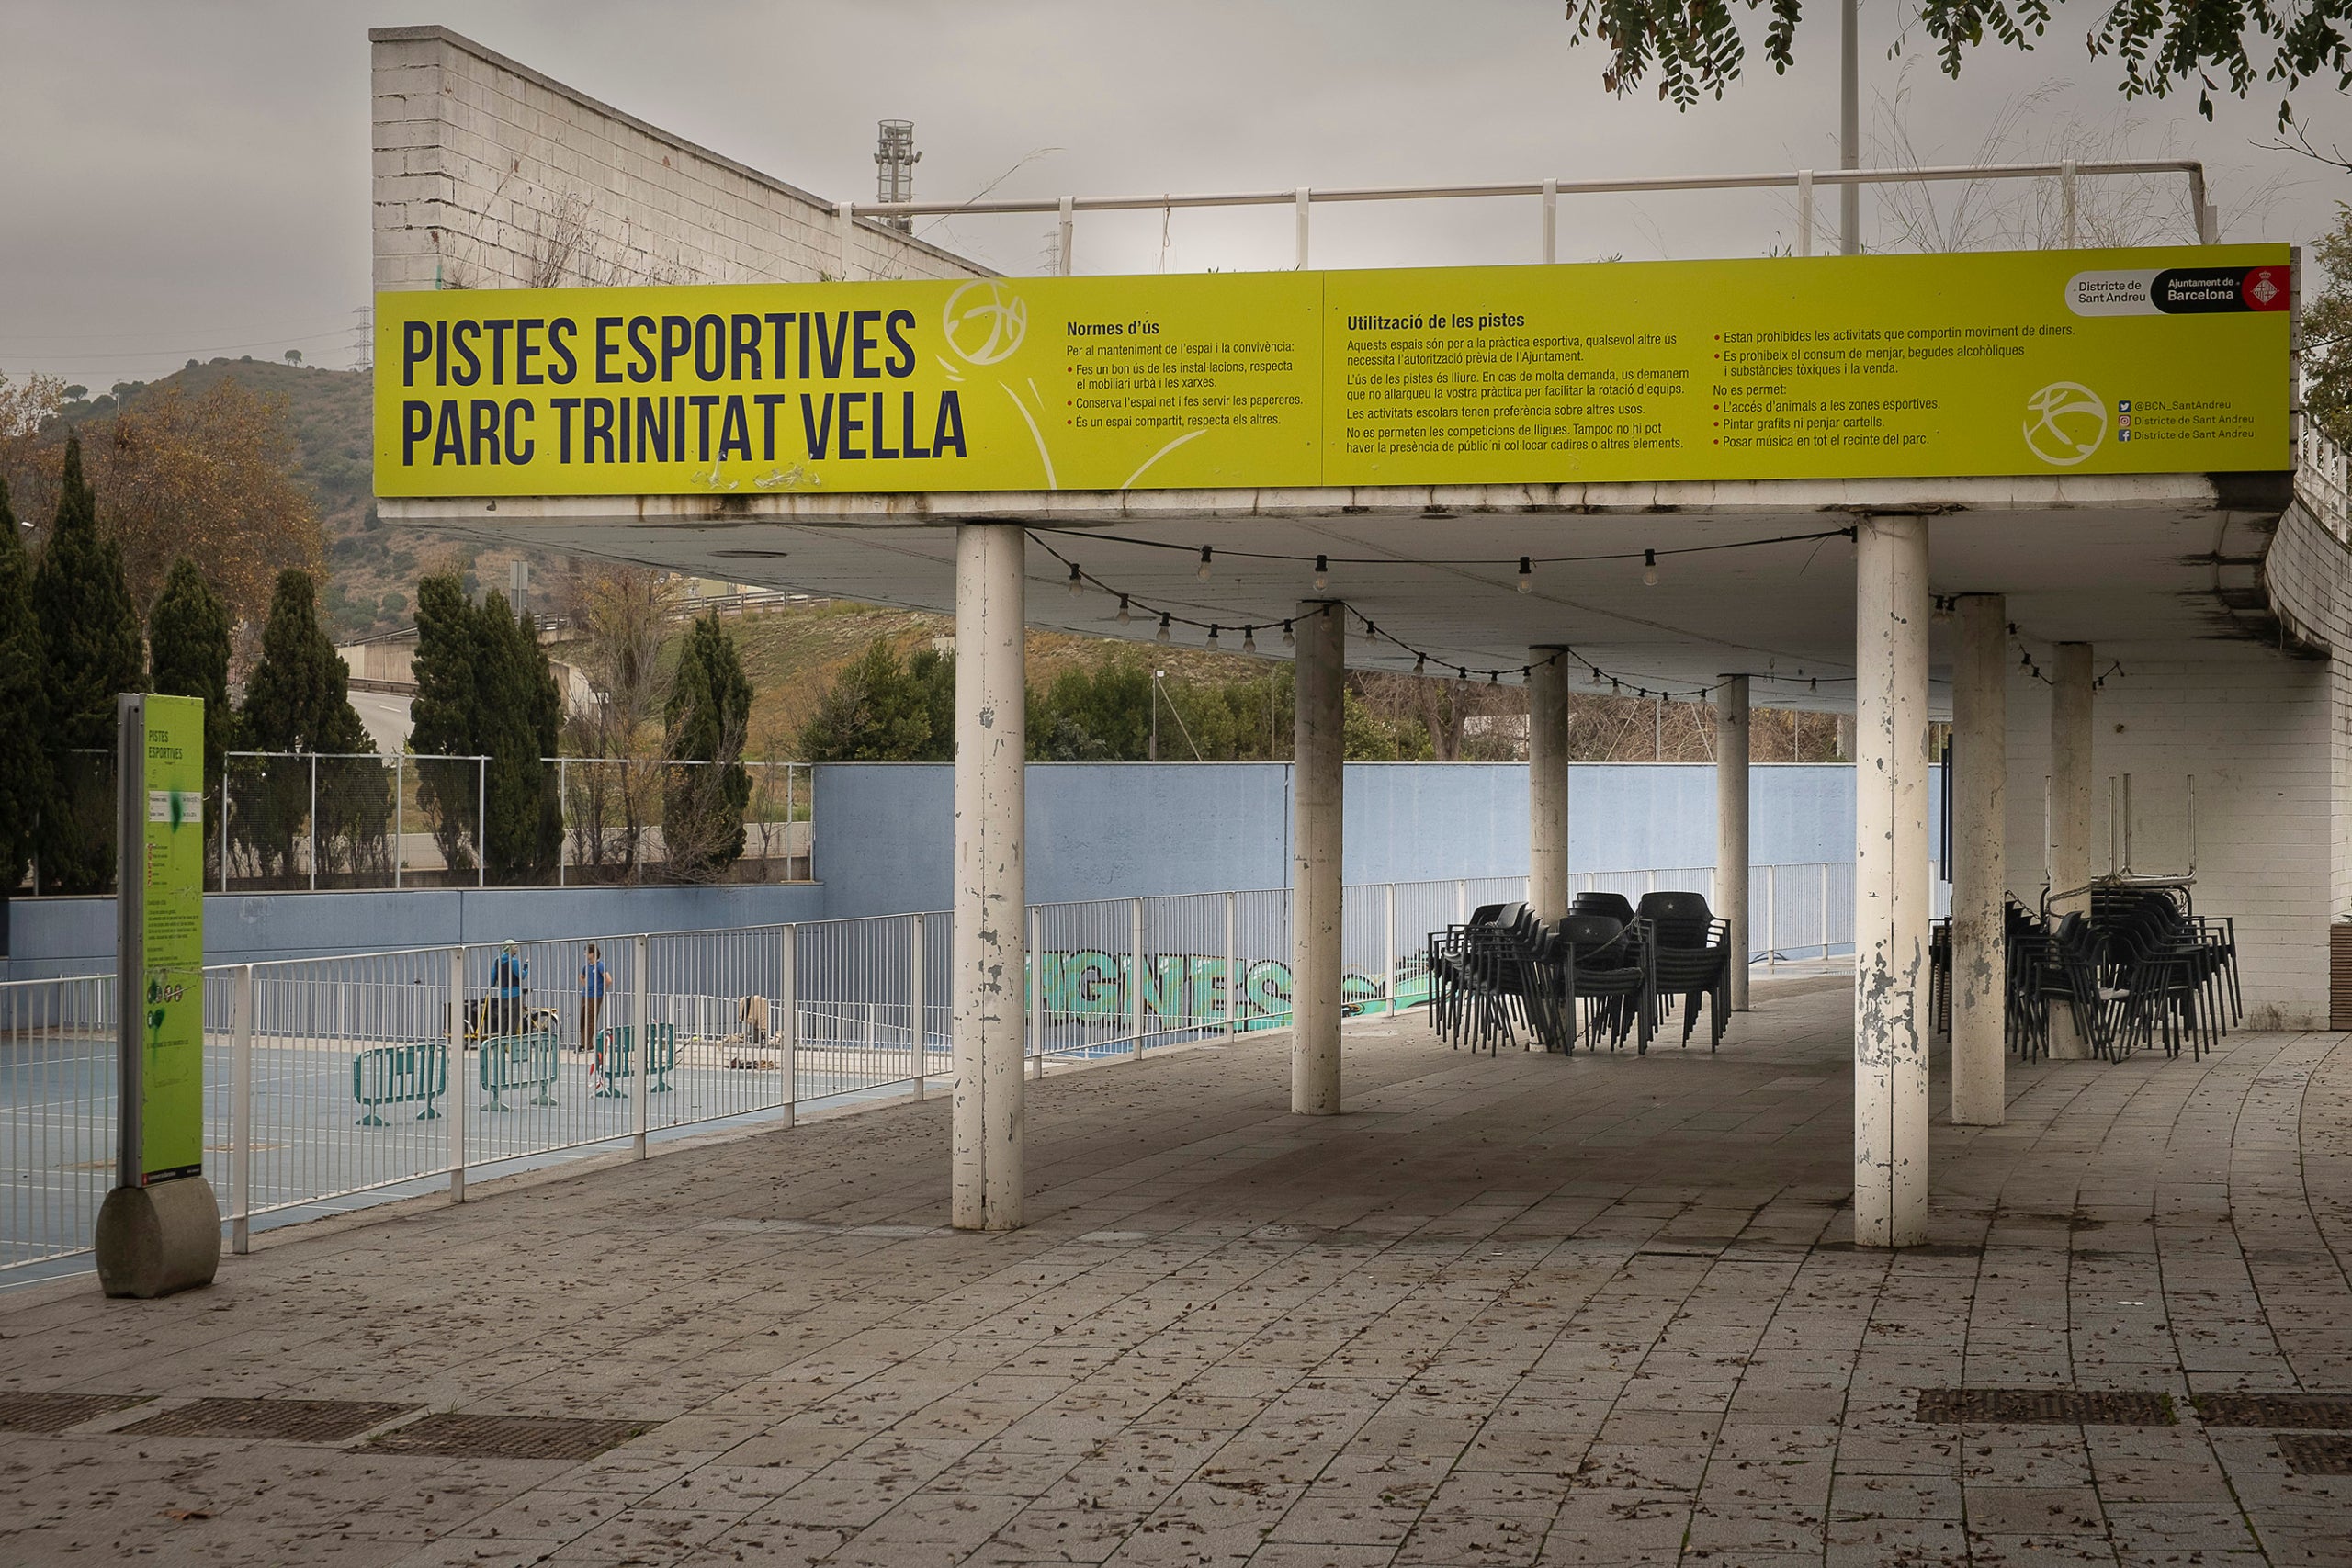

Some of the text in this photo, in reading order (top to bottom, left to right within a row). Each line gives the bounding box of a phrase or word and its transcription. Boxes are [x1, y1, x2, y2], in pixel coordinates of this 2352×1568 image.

[2078, 280, 2141, 291] Districte de
[2168, 277, 2233, 288] Ajuntament de
[2078, 293, 2145, 302] Sant Andreu
[2168, 289, 2233, 301] Barcelona
[1068, 320, 1159, 335] Normes d'ús
[1348, 312, 1524, 330] Utilització de les pistes
[1724, 324, 2075, 344] Estan prohibides les activitats que comportin moviment de diners.
[403, 310, 915, 386] PISTES ESPORTIVES
[1067, 345, 1082, 355] Per
[1085, 344, 1094, 355] al
[1097, 344, 1162, 355] manteniment
[1165, 344, 1177, 354] de
[1181, 342, 1212, 355] l'espai
[1222, 342, 1230, 352] la
[1233, 341, 1294, 352] convivència:
[1347, 333, 1677, 353] Aquests espais són per a la pràctica esportiva, qualsevol altre ús
[1347, 350, 1583, 365] necessita l'autorització prèvia de l'Ajuntament.
[1724, 344, 2024, 363] Es prohibeix el consum de menjar, begudes alcohòliques
[1076, 360, 1293, 374] Fes un bon ús de les instal·lacions, respecta
[1731, 364, 1793, 376] substàncies
[1796, 363, 1840, 377] tòxiques
[1851, 362, 1860, 374] la
[1863, 362, 1898, 373] venda.
[1077, 378, 1085, 389] el
[1089, 378, 1130, 389] mobiliari
[1134, 377, 1156, 388] urbà
[1165, 378, 1179, 388] les
[1182, 378, 1216, 387] xarxes.
[1347, 368, 1689, 385] L'ús de les pistes és lliure. En cas de molta demanda, us demanem
[1713, 383, 1786, 397] No es permet:
[1076, 397, 1122, 408] Conserva
[1125, 396, 1156, 409] l'espai
[1159, 397, 1175, 406] net
[1184, 395, 1199, 406] fes
[1202, 395, 1230, 406] servir
[1233, 395, 1247, 405] les
[1250, 396, 1303, 407] papereres.
[1724, 398, 1940, 412] L'accés d'animals a les zones esportives.
[2134, 400, 2231, 411] @BCN_SantAndreu
[1347, 403, 1645, 419] Les activitats escolars tenen preferència sobre altres usos.
[1076, 413, 1281, 428] És un espai compartit, respecta els altres.
[1724, 416, 1884, 431] Pintar grafits ni penjar cartells.
[2134, 414, 2254, 424] Districte de Sant Andreu
[403, 390, 967, 465] PARC TRINITAT VELLA
[2134, 428, 2254, 440] Districte de Sant Andreu
[1723, 433, 1928, 446] Posar música en tot el recinte del parc.
[149, 730, 169, 742] PISTES
